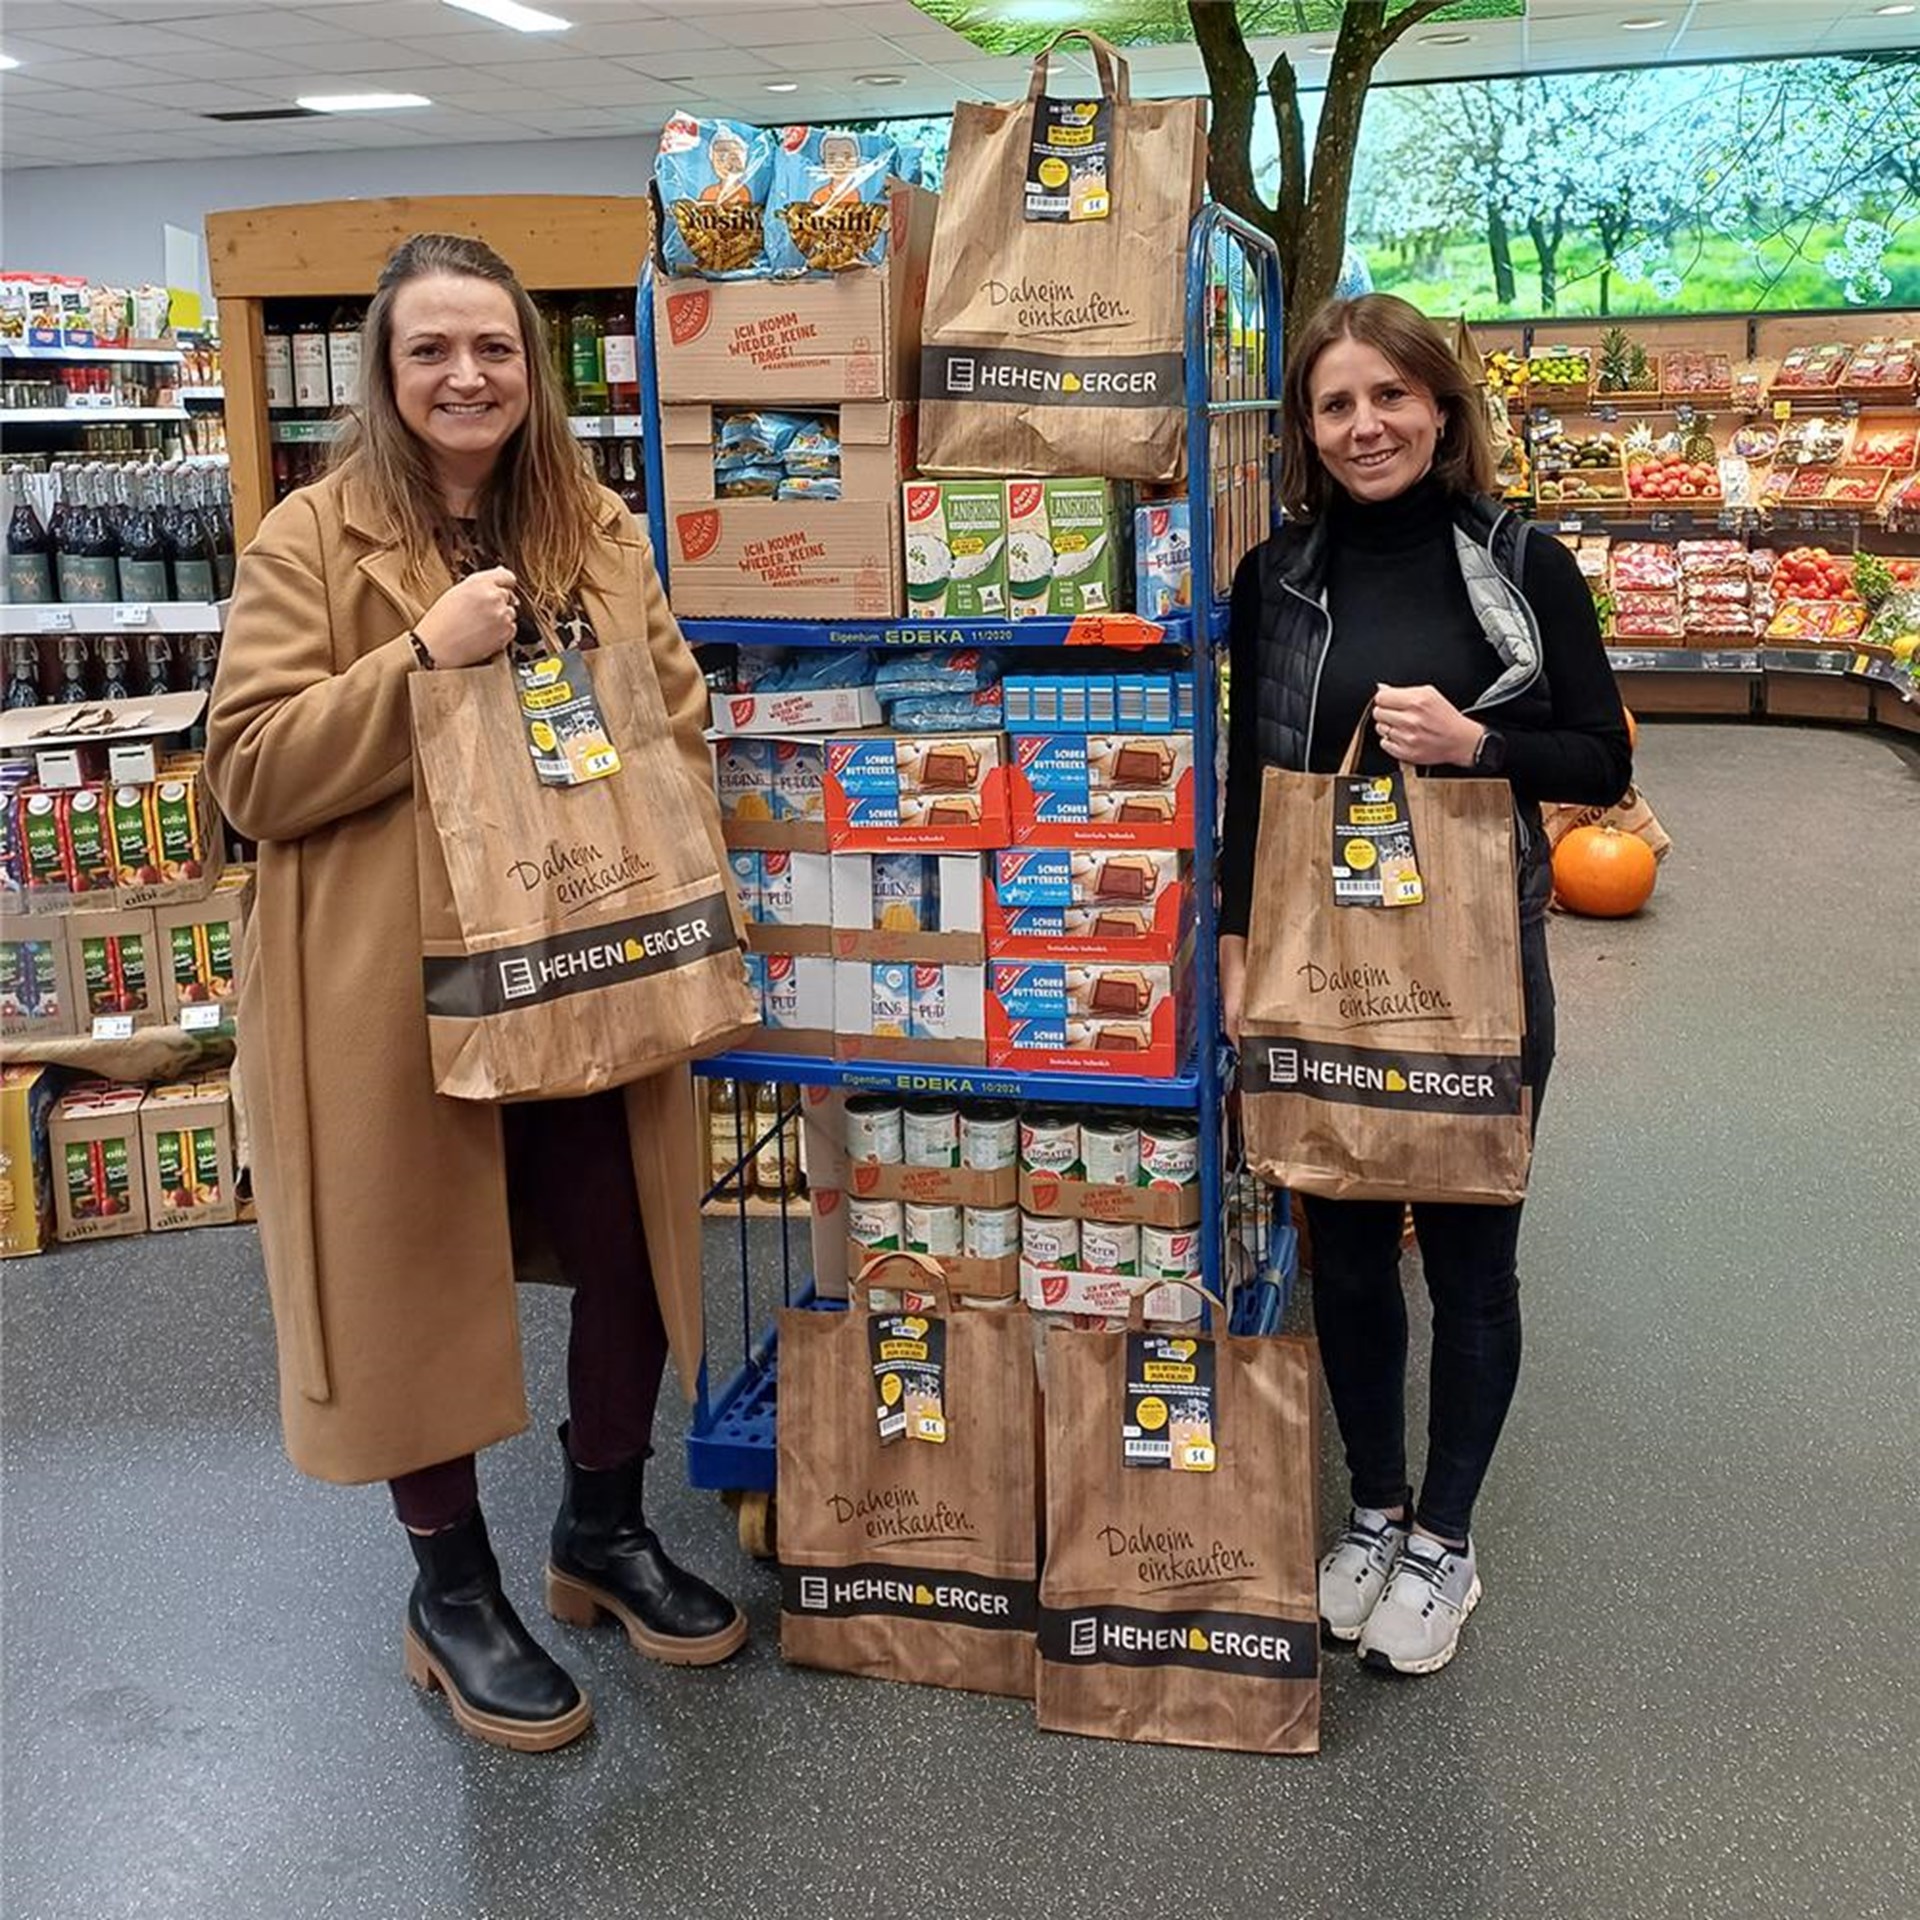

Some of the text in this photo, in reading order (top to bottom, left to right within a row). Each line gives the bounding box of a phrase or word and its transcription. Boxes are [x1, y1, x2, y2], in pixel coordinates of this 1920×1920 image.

[980, 277, 1075, 307] Daheim
[1017, 294, 1131, 329] einkaufen.
[734, 312, 799, 341] ICH KOMM
[781, 324, 818, 345] KEINE
[743, 531, 808, 558] ICH KOMM
[790, 542, 827, 562] KEINE
[829, 631, 881, 643] Eigentum
[885, 629, 965, 644] EDEKA
[506, 838, 604, 892] Daheim
[125, 889, 158, 907] albi
[1298, 960, 1392, 994] Daheim
[1338, 981, 1453, 1020] einkaufen.
[842, 1072, 892, 1086] Eigentum
[896, 1075, 974, 1092] EDEKA
[65, 1223, 99, 1239] albi
[156, 1211, 190, 1229] albi
[826, 1484, 920, 1525] Daheim
[866, 1501, 976, 1540] einkaufen.
[1096, 1523, 1194, 1558] Daheim
[1137, 1542, 1256, 1584] einkaufen.
